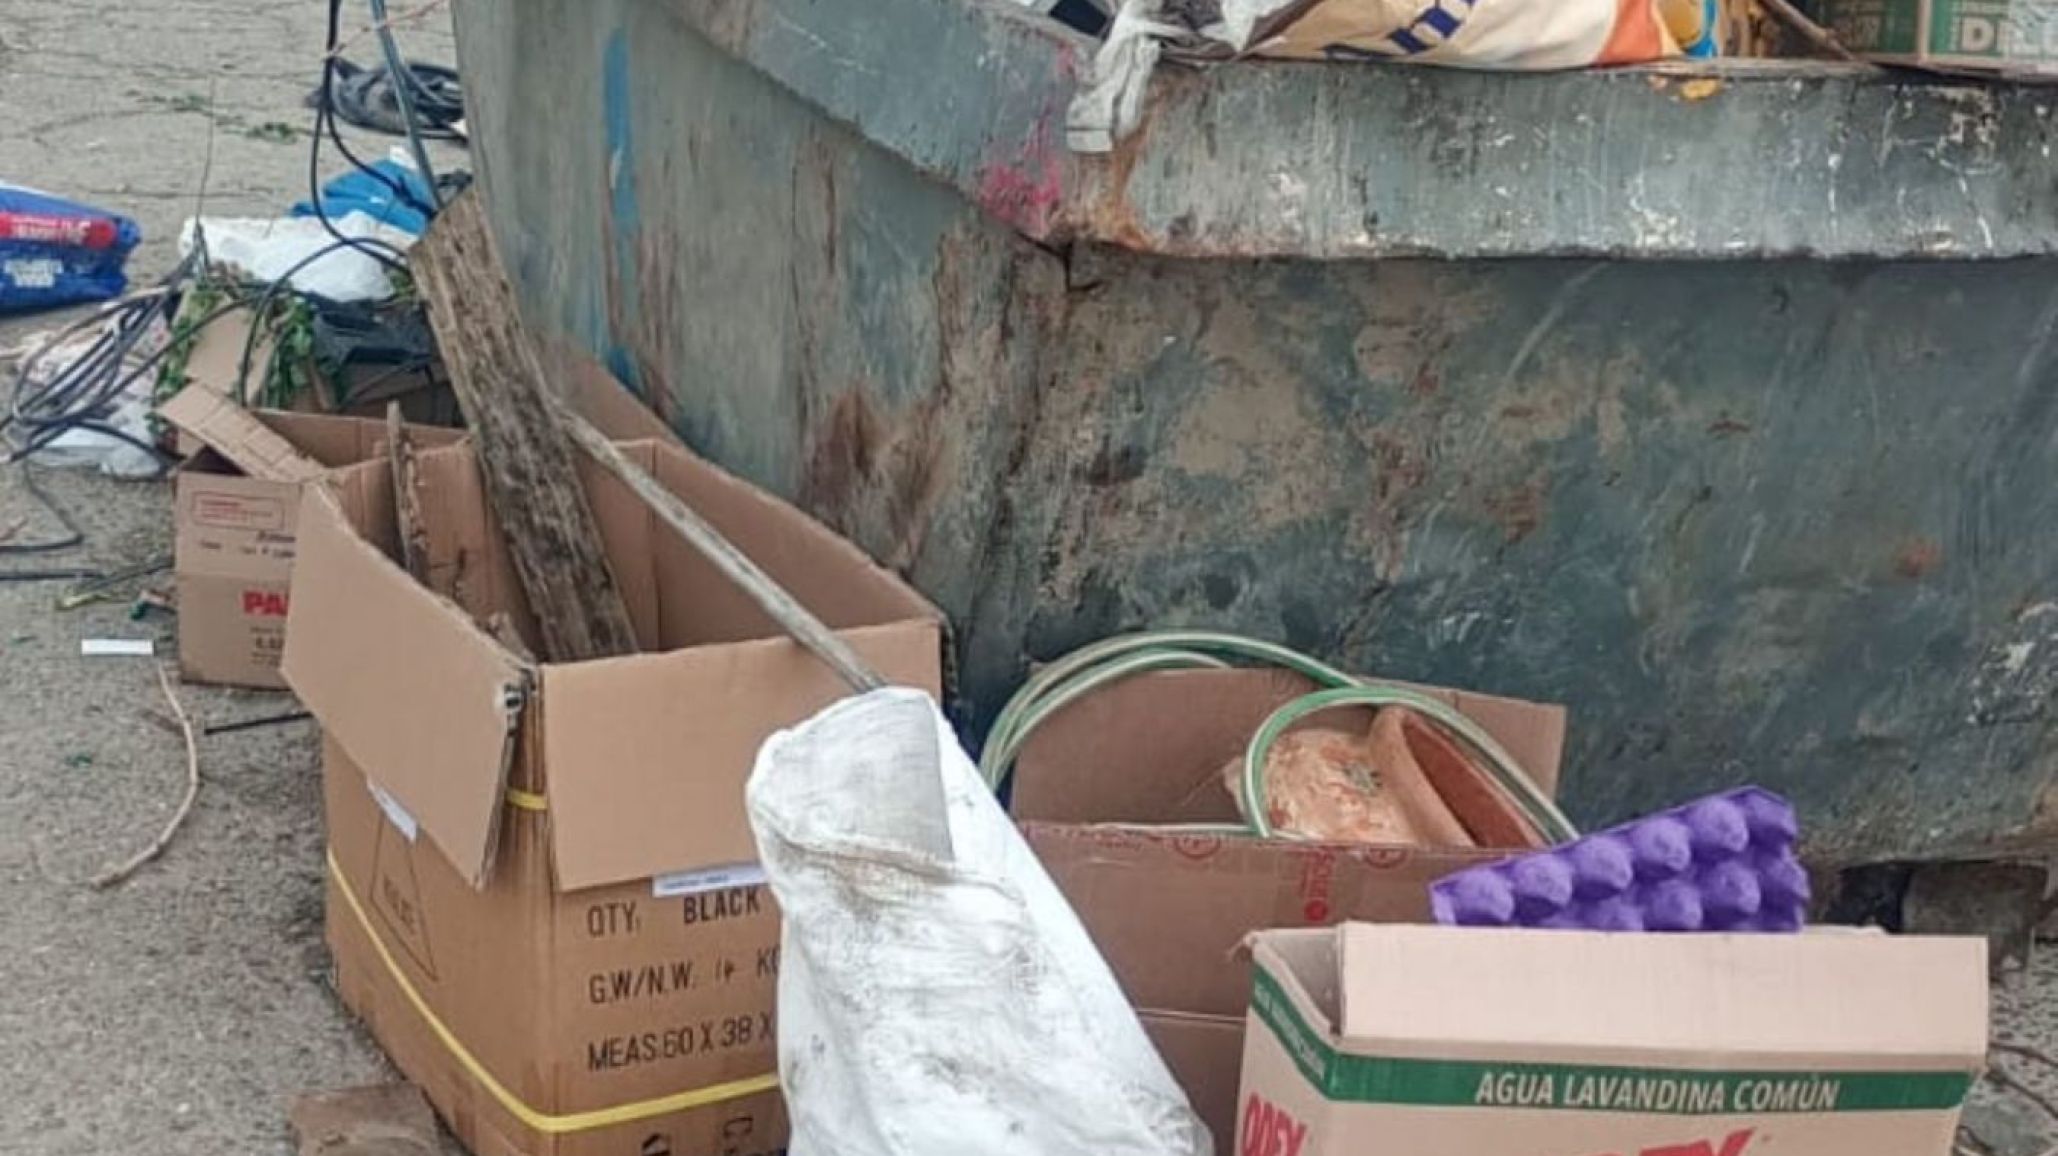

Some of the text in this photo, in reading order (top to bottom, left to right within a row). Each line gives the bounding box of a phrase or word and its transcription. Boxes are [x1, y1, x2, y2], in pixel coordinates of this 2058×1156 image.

[243, 589, 289, 617] PA
[684, 886, 761, 924] BLACK
[700, 1019, 714, 1052] X
[721, 1014, 753, 1047] 38
[1475, 1070, 1841, 1111] AGUA LAVANDINA COMÚN
